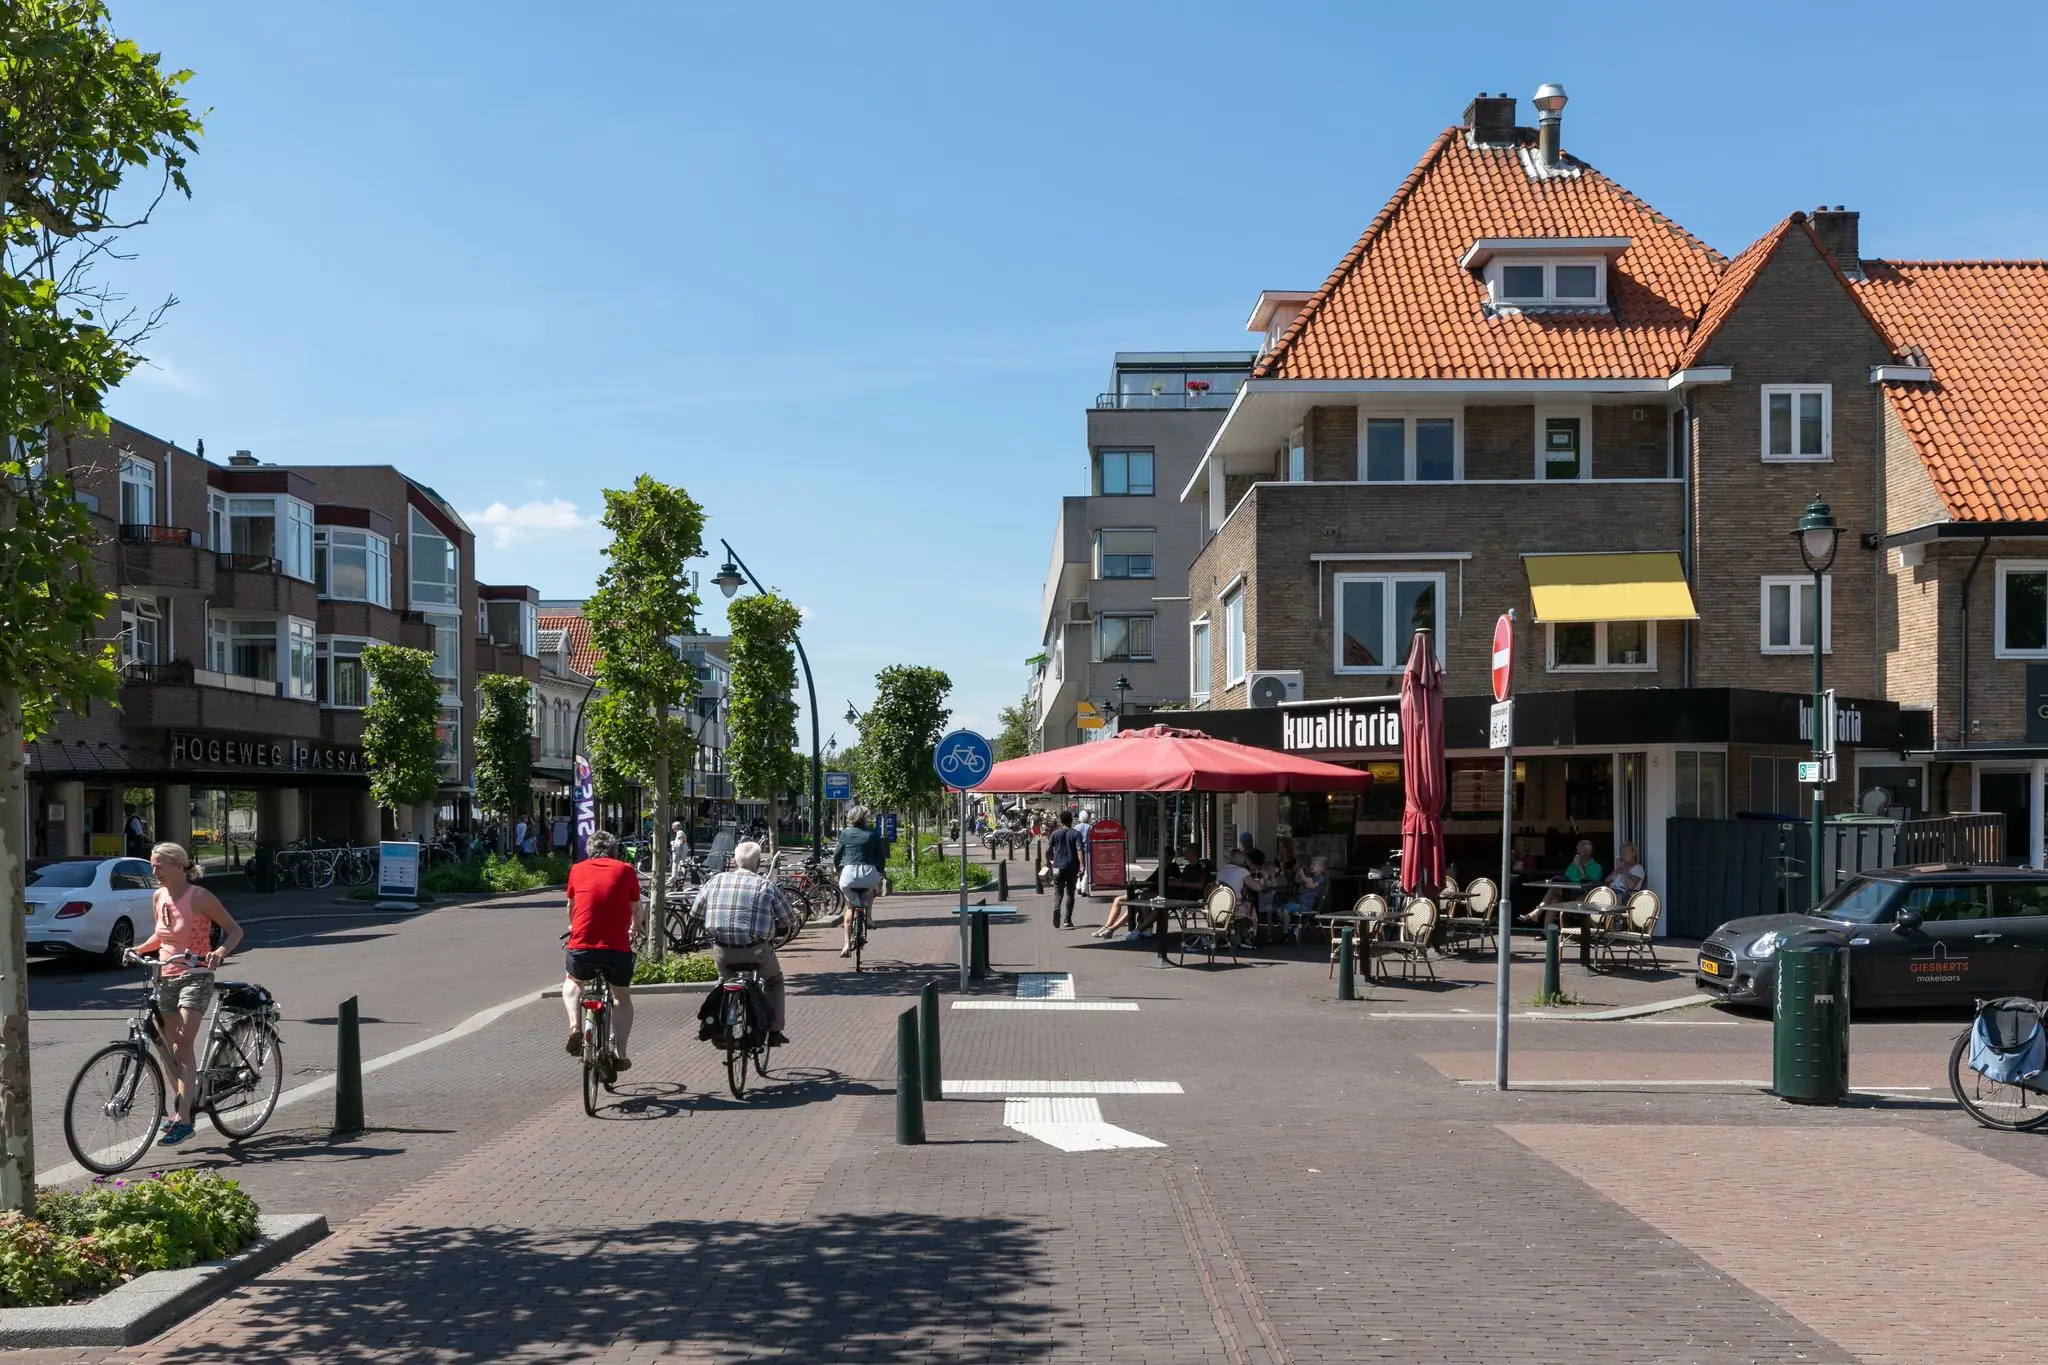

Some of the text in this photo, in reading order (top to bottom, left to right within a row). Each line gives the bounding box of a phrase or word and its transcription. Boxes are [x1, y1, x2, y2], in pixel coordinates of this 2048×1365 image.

[1283, 706, 1399, 750] kwalitaria
[1800, 699, 1862, 742] kwtaria
[174, 736, 368, 772] HOGEWEG PASSAG
[1910, 962, 1969, 973] GIESBERTS
[1916, 974, 1961, 982] makelaars
